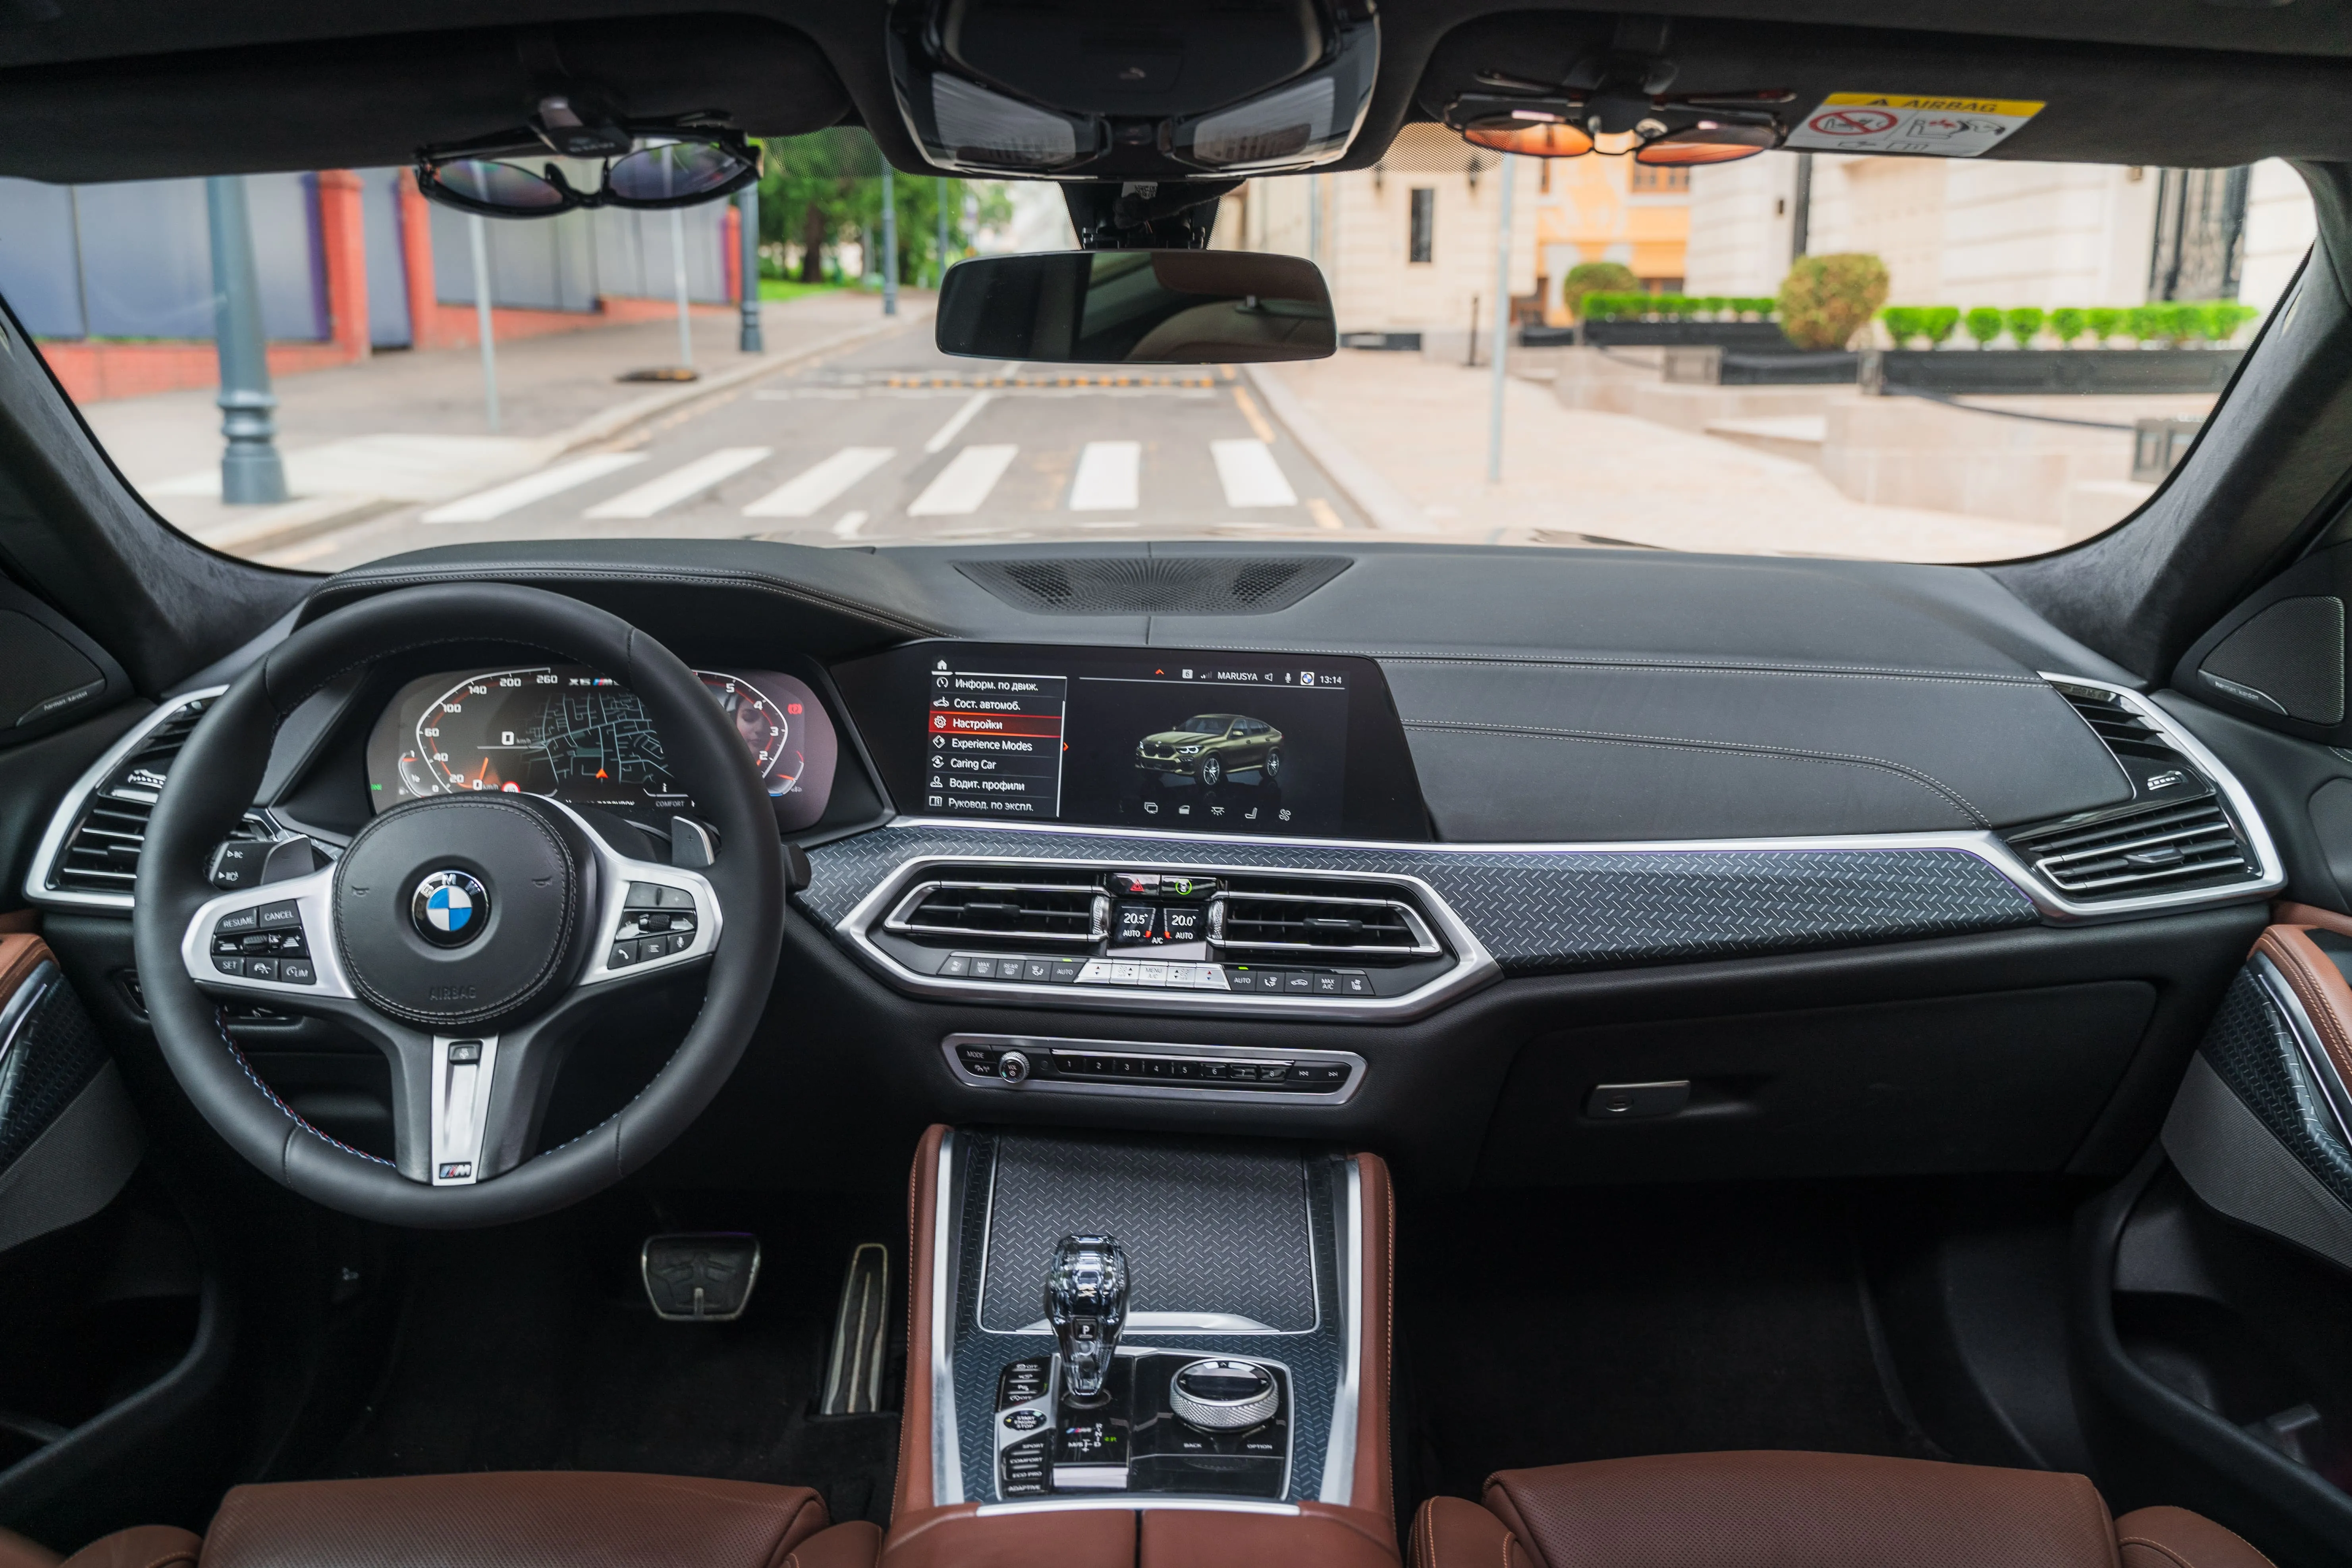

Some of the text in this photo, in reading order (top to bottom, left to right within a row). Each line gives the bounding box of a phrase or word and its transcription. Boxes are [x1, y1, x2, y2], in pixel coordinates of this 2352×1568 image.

[1904, 98, 1997, 113] AIRBAG
[536, 675, 558, 684] 260
[1217, 671, 1258, 681] MARUSYA
[1320, 675, 1342, 684] 13:14
[500, 678, 521, 687] 200
[955, 679, 996, 690] Информ.
[1011, 683, 1038, 691] движ.
[468, 685, 487, 695] 140
[726, 683, 735, 693] 5
[444, 704, 461, 713] 100
[754, 700, 763, 711] 4
[954, 698, 1021, 710] Сост. автомоб.
[953, 718, 1003, 730] Настройки
[424, 727, 440, 737] 60
[770, 726, 779, 736] 3
[502, 731, 514, 745] 0
[952, 739, 1033, 751] Experience Modes
[433, 752, 449, 762] 40
[759, 751, 768, 760] 2
[950, 758, 997, 770] Caring Car
[450, 773, 464, 783] 20
[473, 779, 483, 791] 0
[949, 778, 1025, 791] Водит. профили
[948, 797, 988, 809] Руковод.
[1004, 802, 1034, 811] экспл.
[420, 873, 481, 898] BMW
[264, 910, 294, 921] CANCEL
[223, 915, 255, 928] RESUME
[223, 961, 237, 970] SET
[429, 985, 477, 1000] AIRBAG
[967, 1051, 984, 1059] MODE
[1082, 1325, 1090, 1335] P
